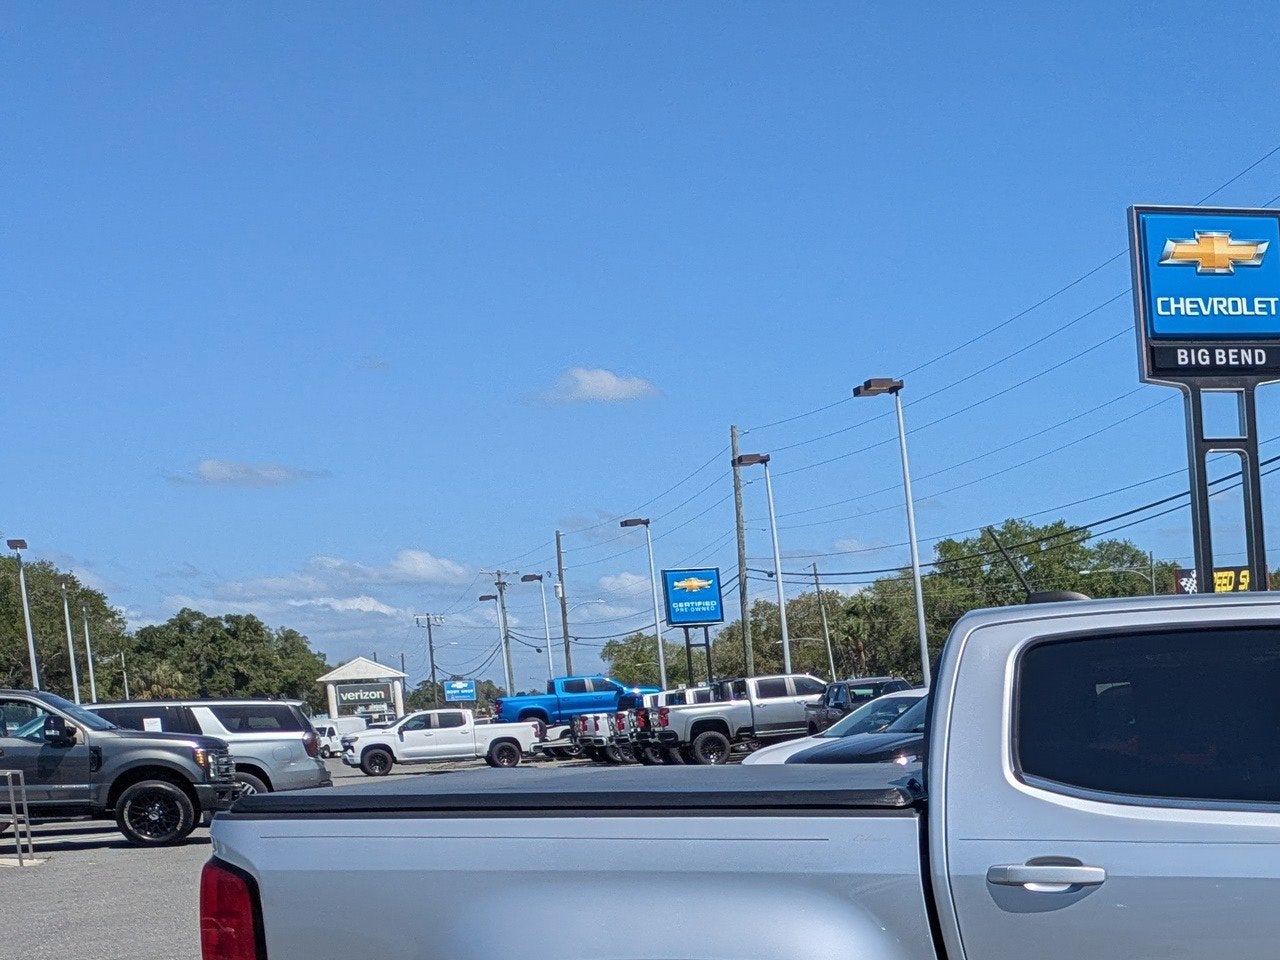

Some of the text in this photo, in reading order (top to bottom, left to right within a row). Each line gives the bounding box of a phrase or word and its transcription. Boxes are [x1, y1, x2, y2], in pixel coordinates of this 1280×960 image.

[1156, 297, 1279, 316] CHEVROLET
[1177, 348, 1266, 365] BIG BEND
[672, 600, 717, 608] CERTIFIED
[341, 690, 385, 701] verizon
